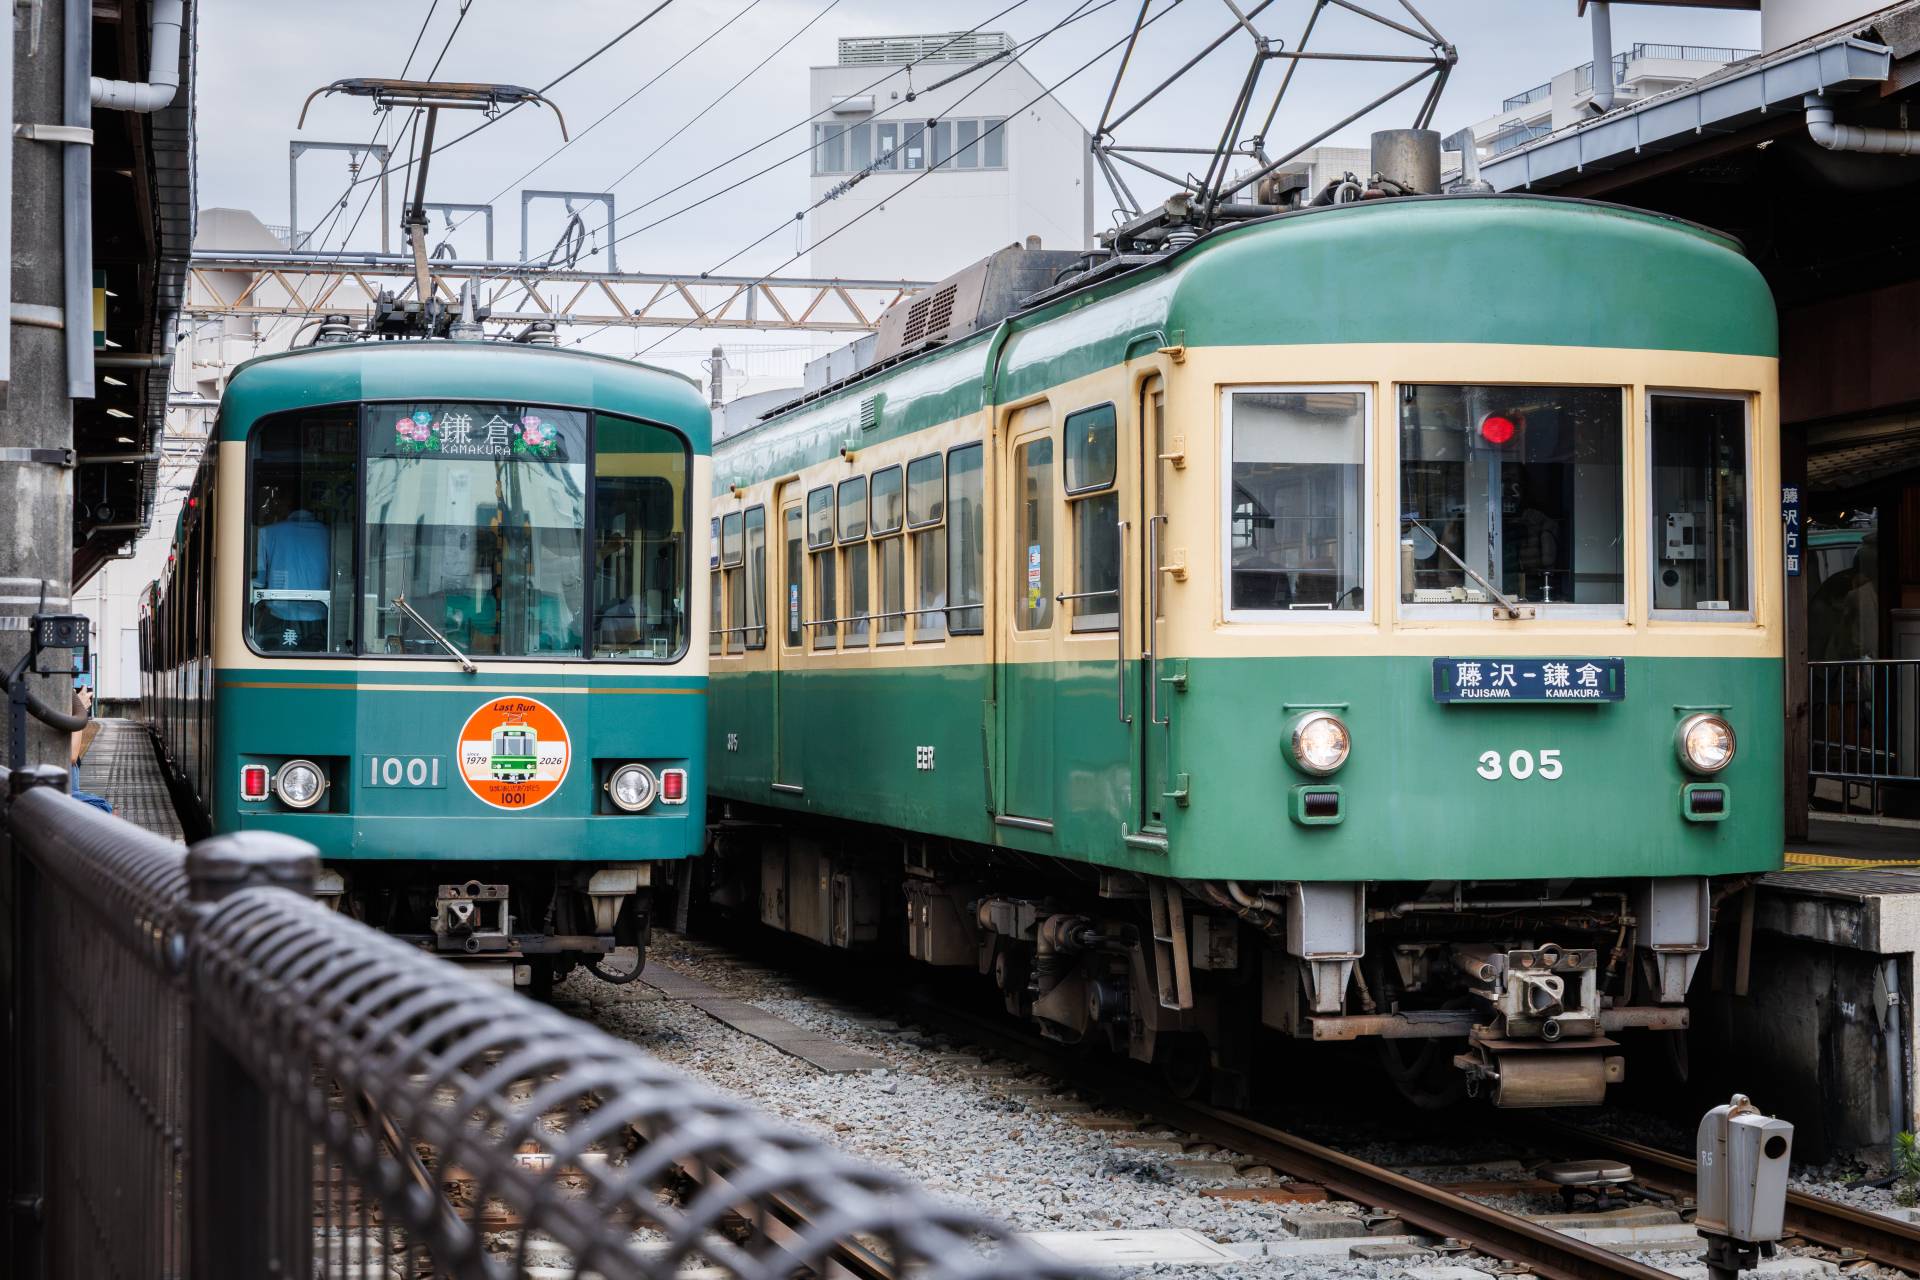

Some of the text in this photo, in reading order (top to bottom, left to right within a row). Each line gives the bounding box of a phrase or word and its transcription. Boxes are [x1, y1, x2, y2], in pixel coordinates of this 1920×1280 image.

[440, 412, 513, 446] 鎌倉
[441, 444, 511, 456] KAMAKURA
[1782, 487, 1798, 571] 藤沢方面
[1461, 688, 1511, 698] FUJISAWA
[1545, 688, 1601, 698] KAMAKURA
[493, 703, 536, 712] Last Run
[466, 756, 488, 765] 1979
[539, 757, 563, 765] 2026
[916, 745, 935, 771] EER
[1476, 749, 1563, 780] 305
[370, 757, 439, 786] 1001
[502, 792, 526, 804] 1001
